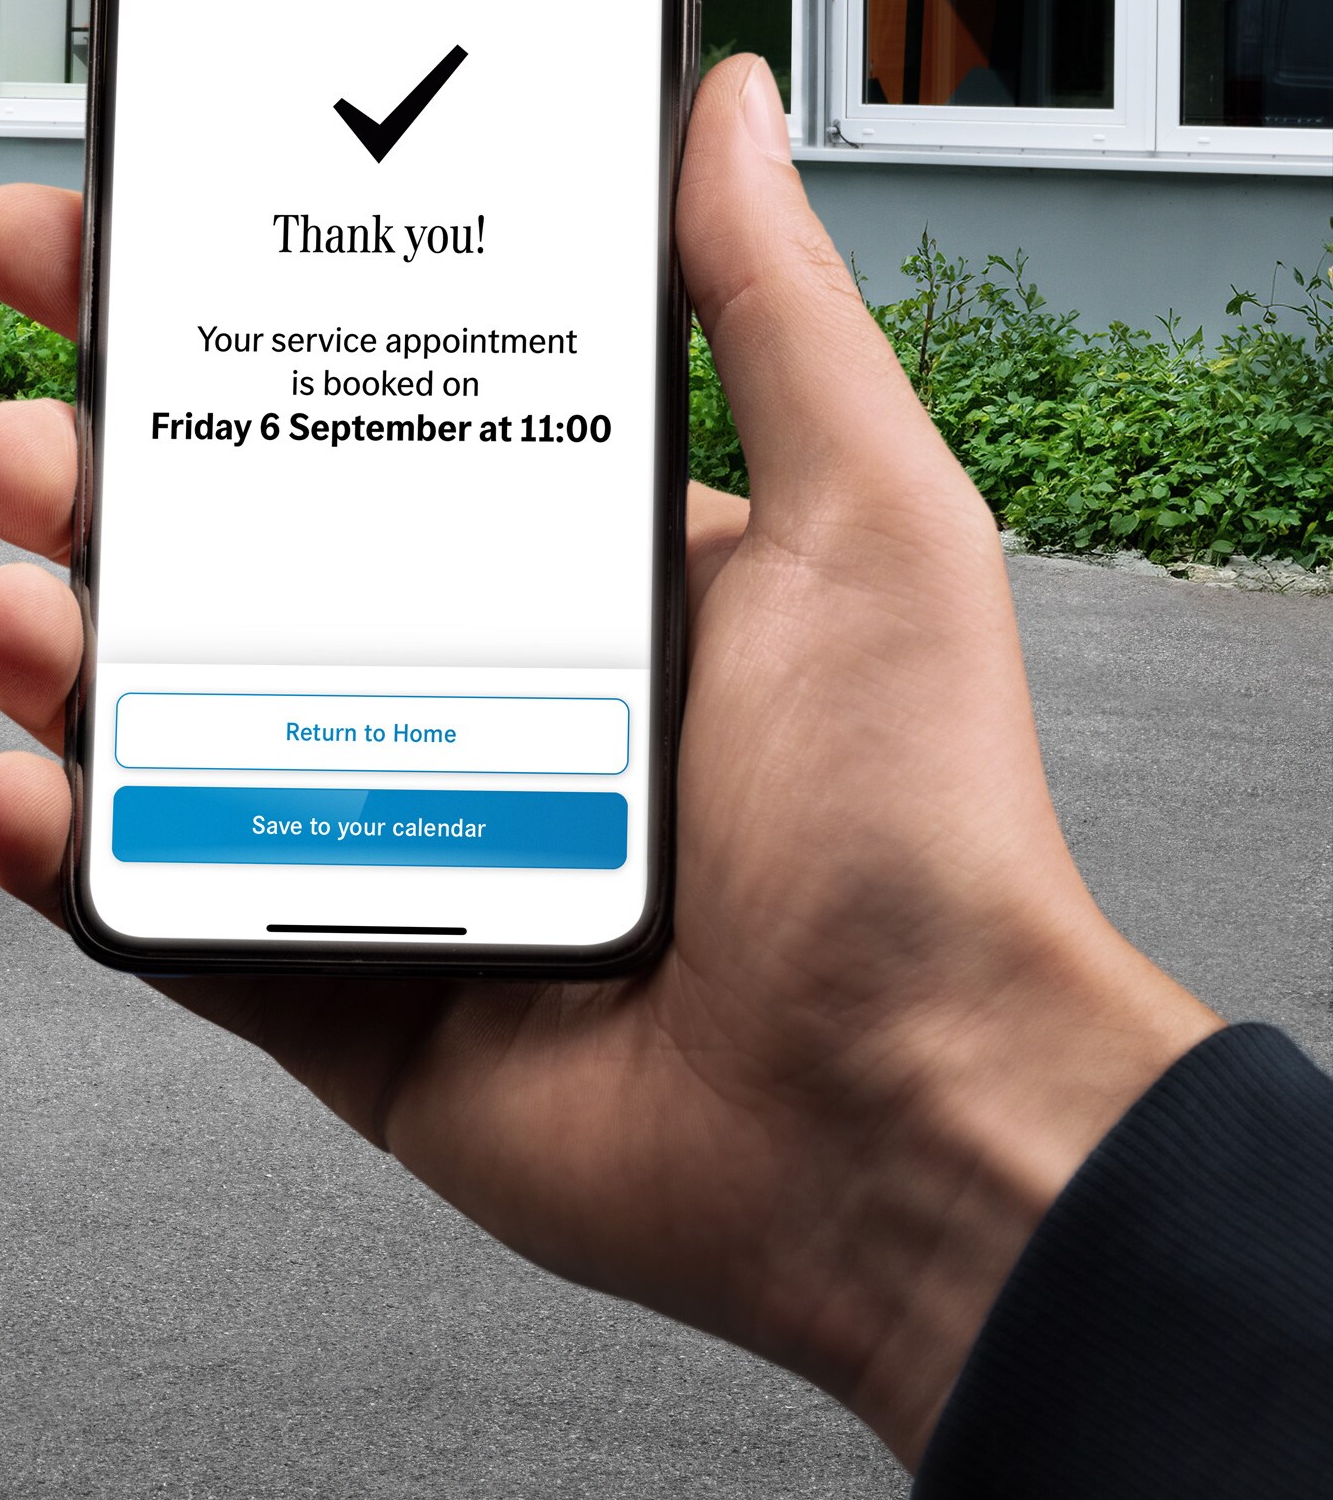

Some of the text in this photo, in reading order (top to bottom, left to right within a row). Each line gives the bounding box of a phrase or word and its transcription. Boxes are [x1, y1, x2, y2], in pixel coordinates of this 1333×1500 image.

[273, 214, 485, 263] Thank you!
[197, 325, 578, 360] Your service appointment
[292, 369, 479, 397] is booked on
[151, 411, 612, 448] Friday 6 September at 11:00
[286, 722, 457, 744] Return to Home
[252, 815, 487, 841] Save to your calendar
